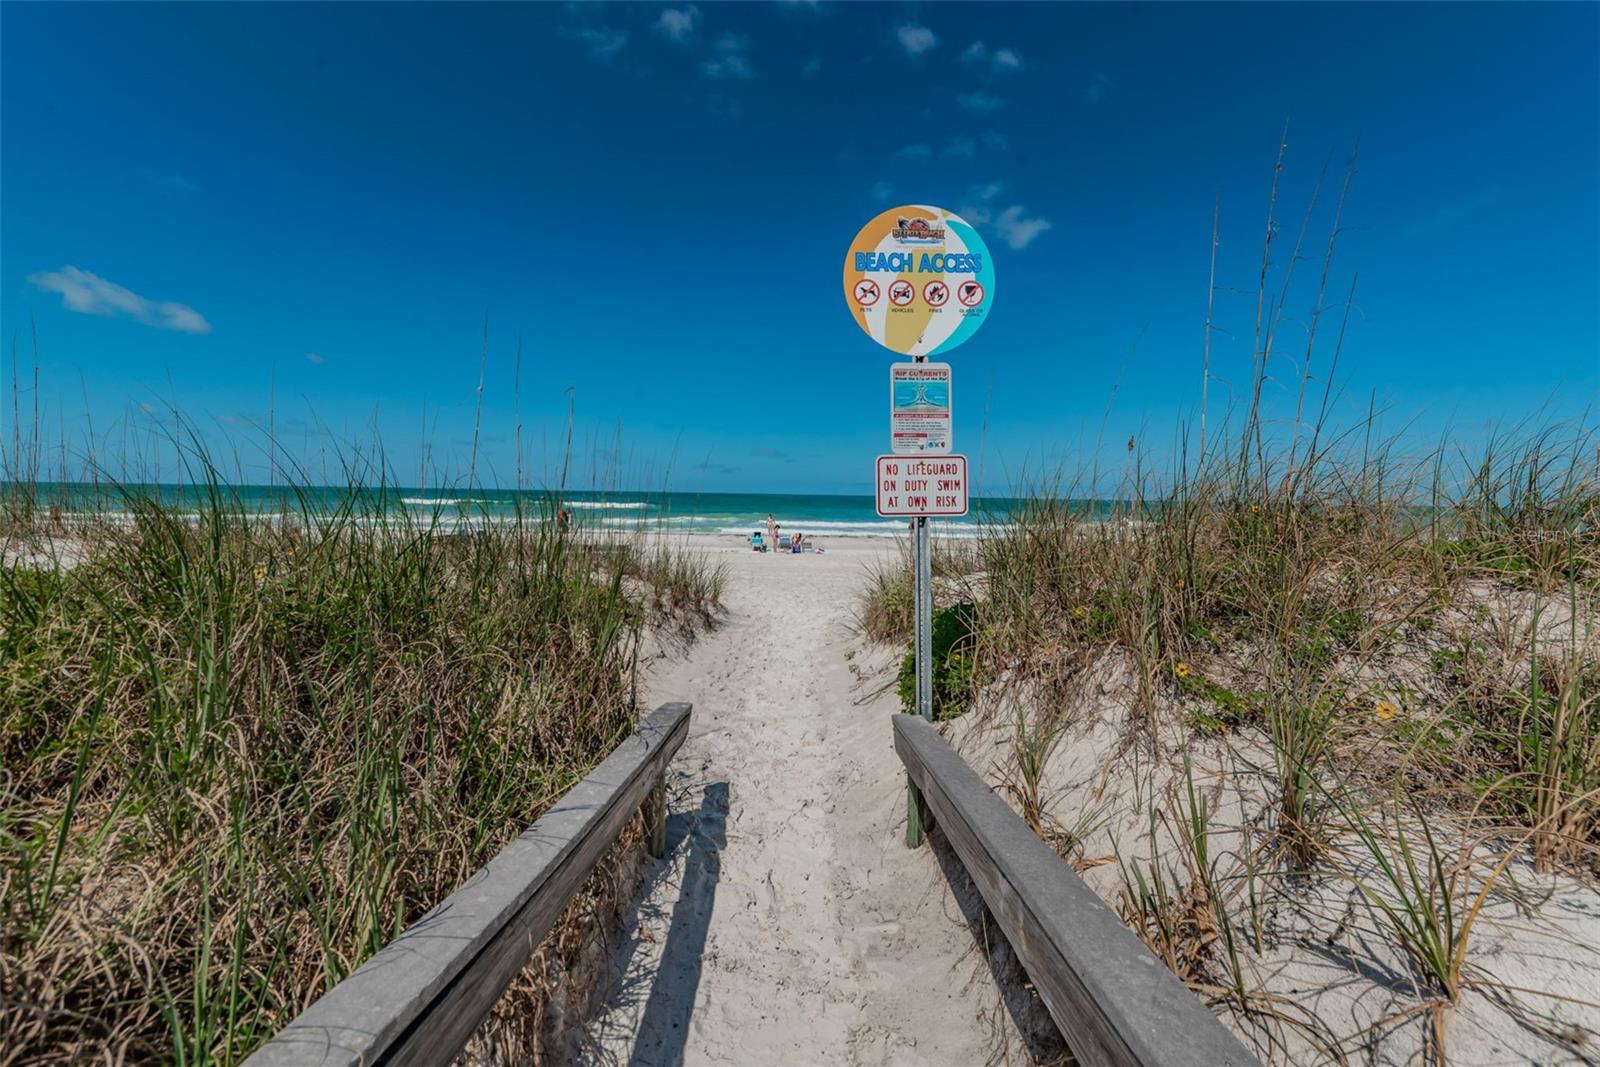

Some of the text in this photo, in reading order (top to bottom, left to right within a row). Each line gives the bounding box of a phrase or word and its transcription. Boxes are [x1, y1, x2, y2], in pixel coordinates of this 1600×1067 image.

[855, 252, 983, 274] BEACH ACCESS
[886, 463, 958, 476] NO LIFEGUARD
[883, 479, 961, 492] ON DUTY SWIM
[887, 495, 957, 508] AT OWN RISK
